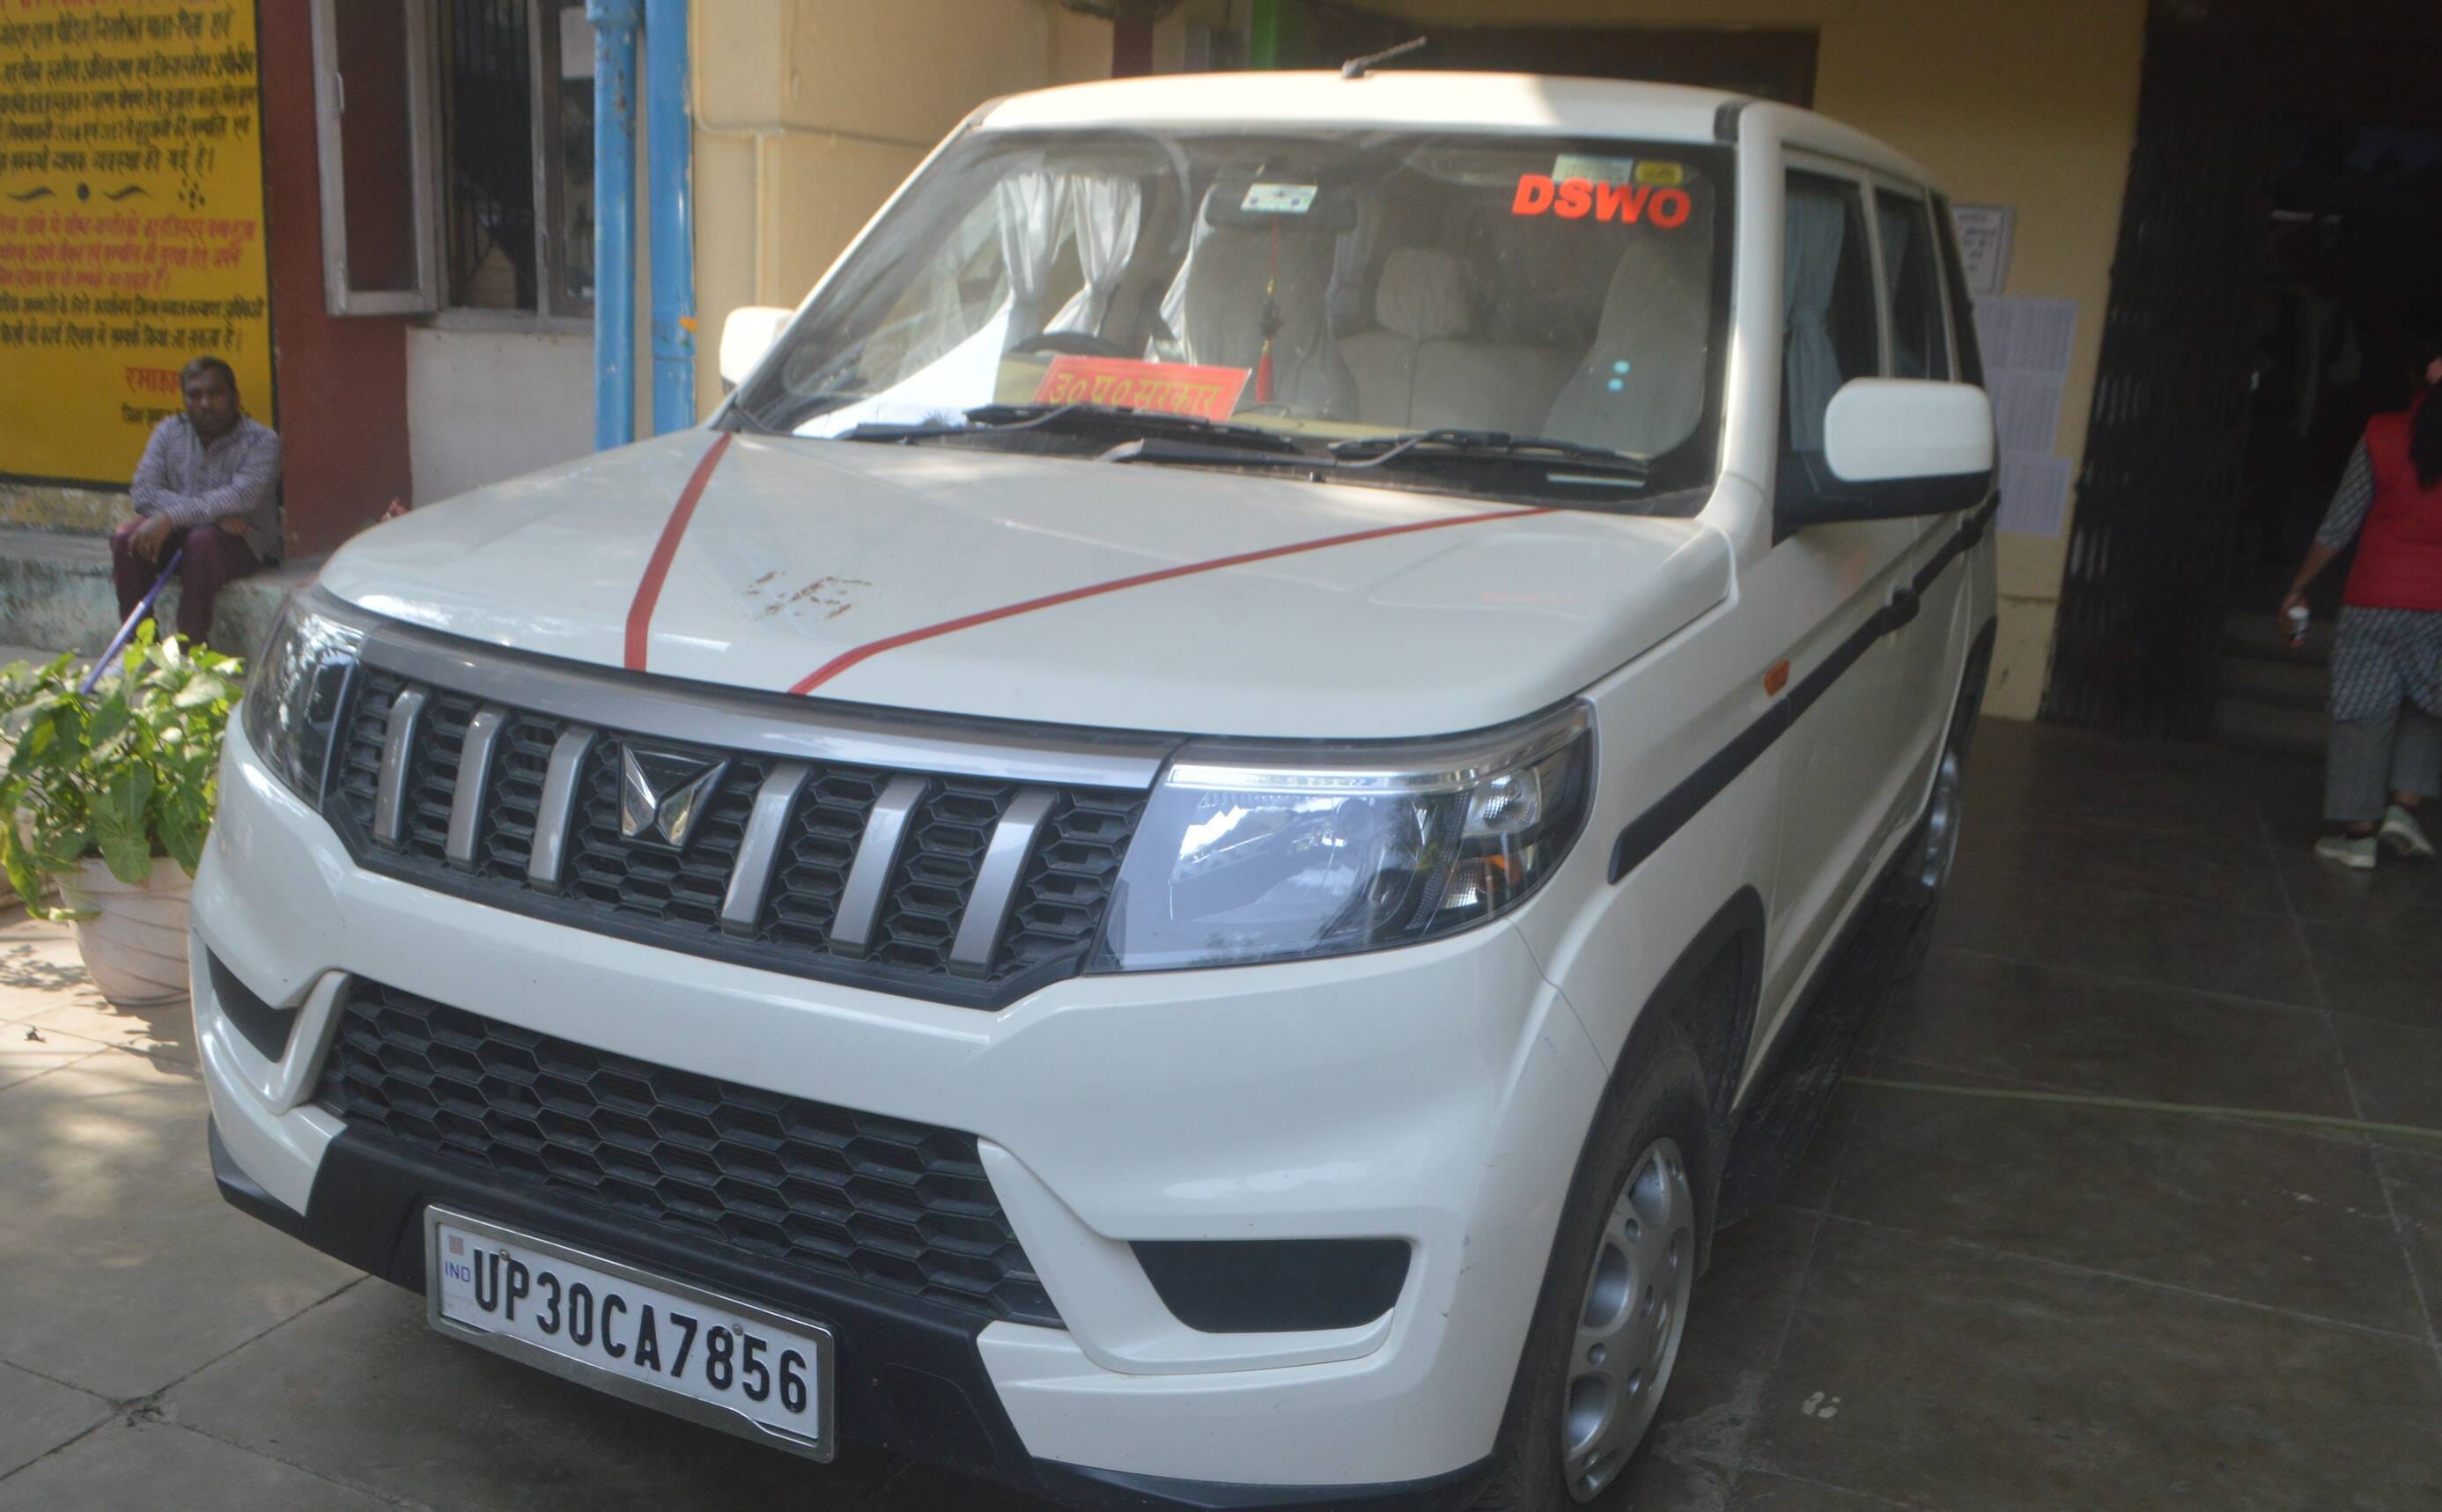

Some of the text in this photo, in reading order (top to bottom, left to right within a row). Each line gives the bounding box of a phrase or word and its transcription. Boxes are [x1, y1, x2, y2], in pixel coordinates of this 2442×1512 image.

[1511, 173, 1692, 230] DSWO
[445, 1260, 471, 1283] IND
[474, 1248, 808, 1414] UP30CA7856
